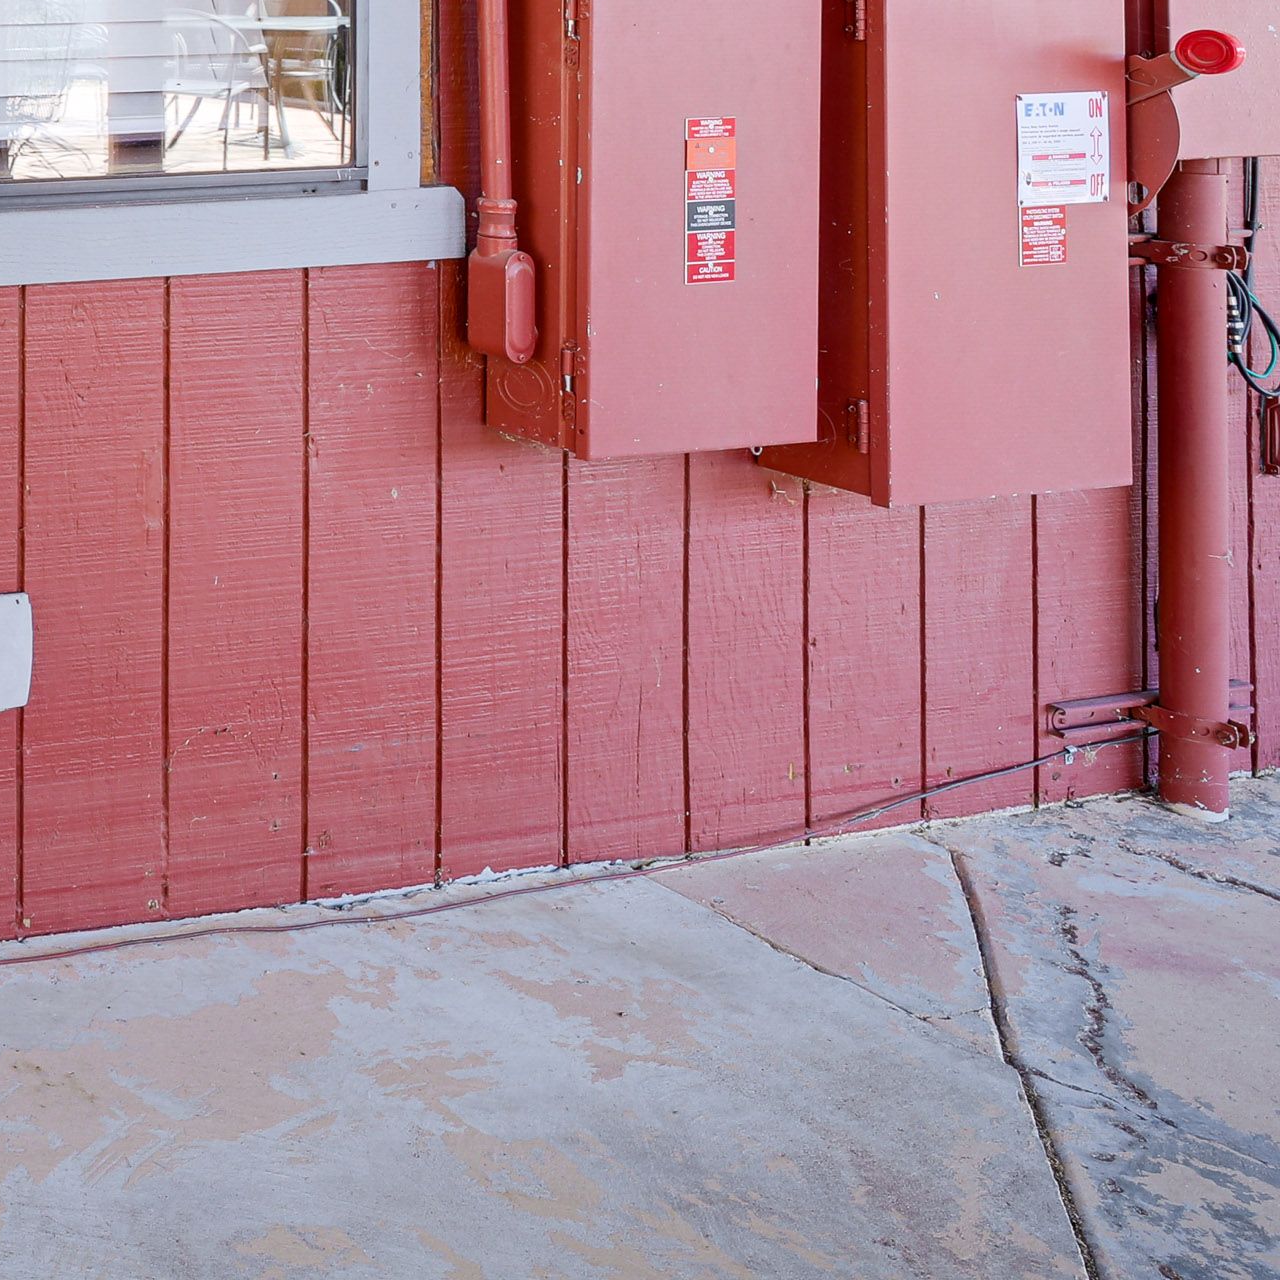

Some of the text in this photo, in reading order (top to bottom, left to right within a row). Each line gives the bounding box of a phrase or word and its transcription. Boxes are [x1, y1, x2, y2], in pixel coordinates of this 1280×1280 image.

[1088, 97, 1103, 118] ON
[696, 170, 726, 179] WARNING
[1090, 173, 1105, 197] OFF
[696, 204, 726, 213] WARNING
[696, 232, 726, 241] WARNING
[699, 265, 723, 274] CAUTION
